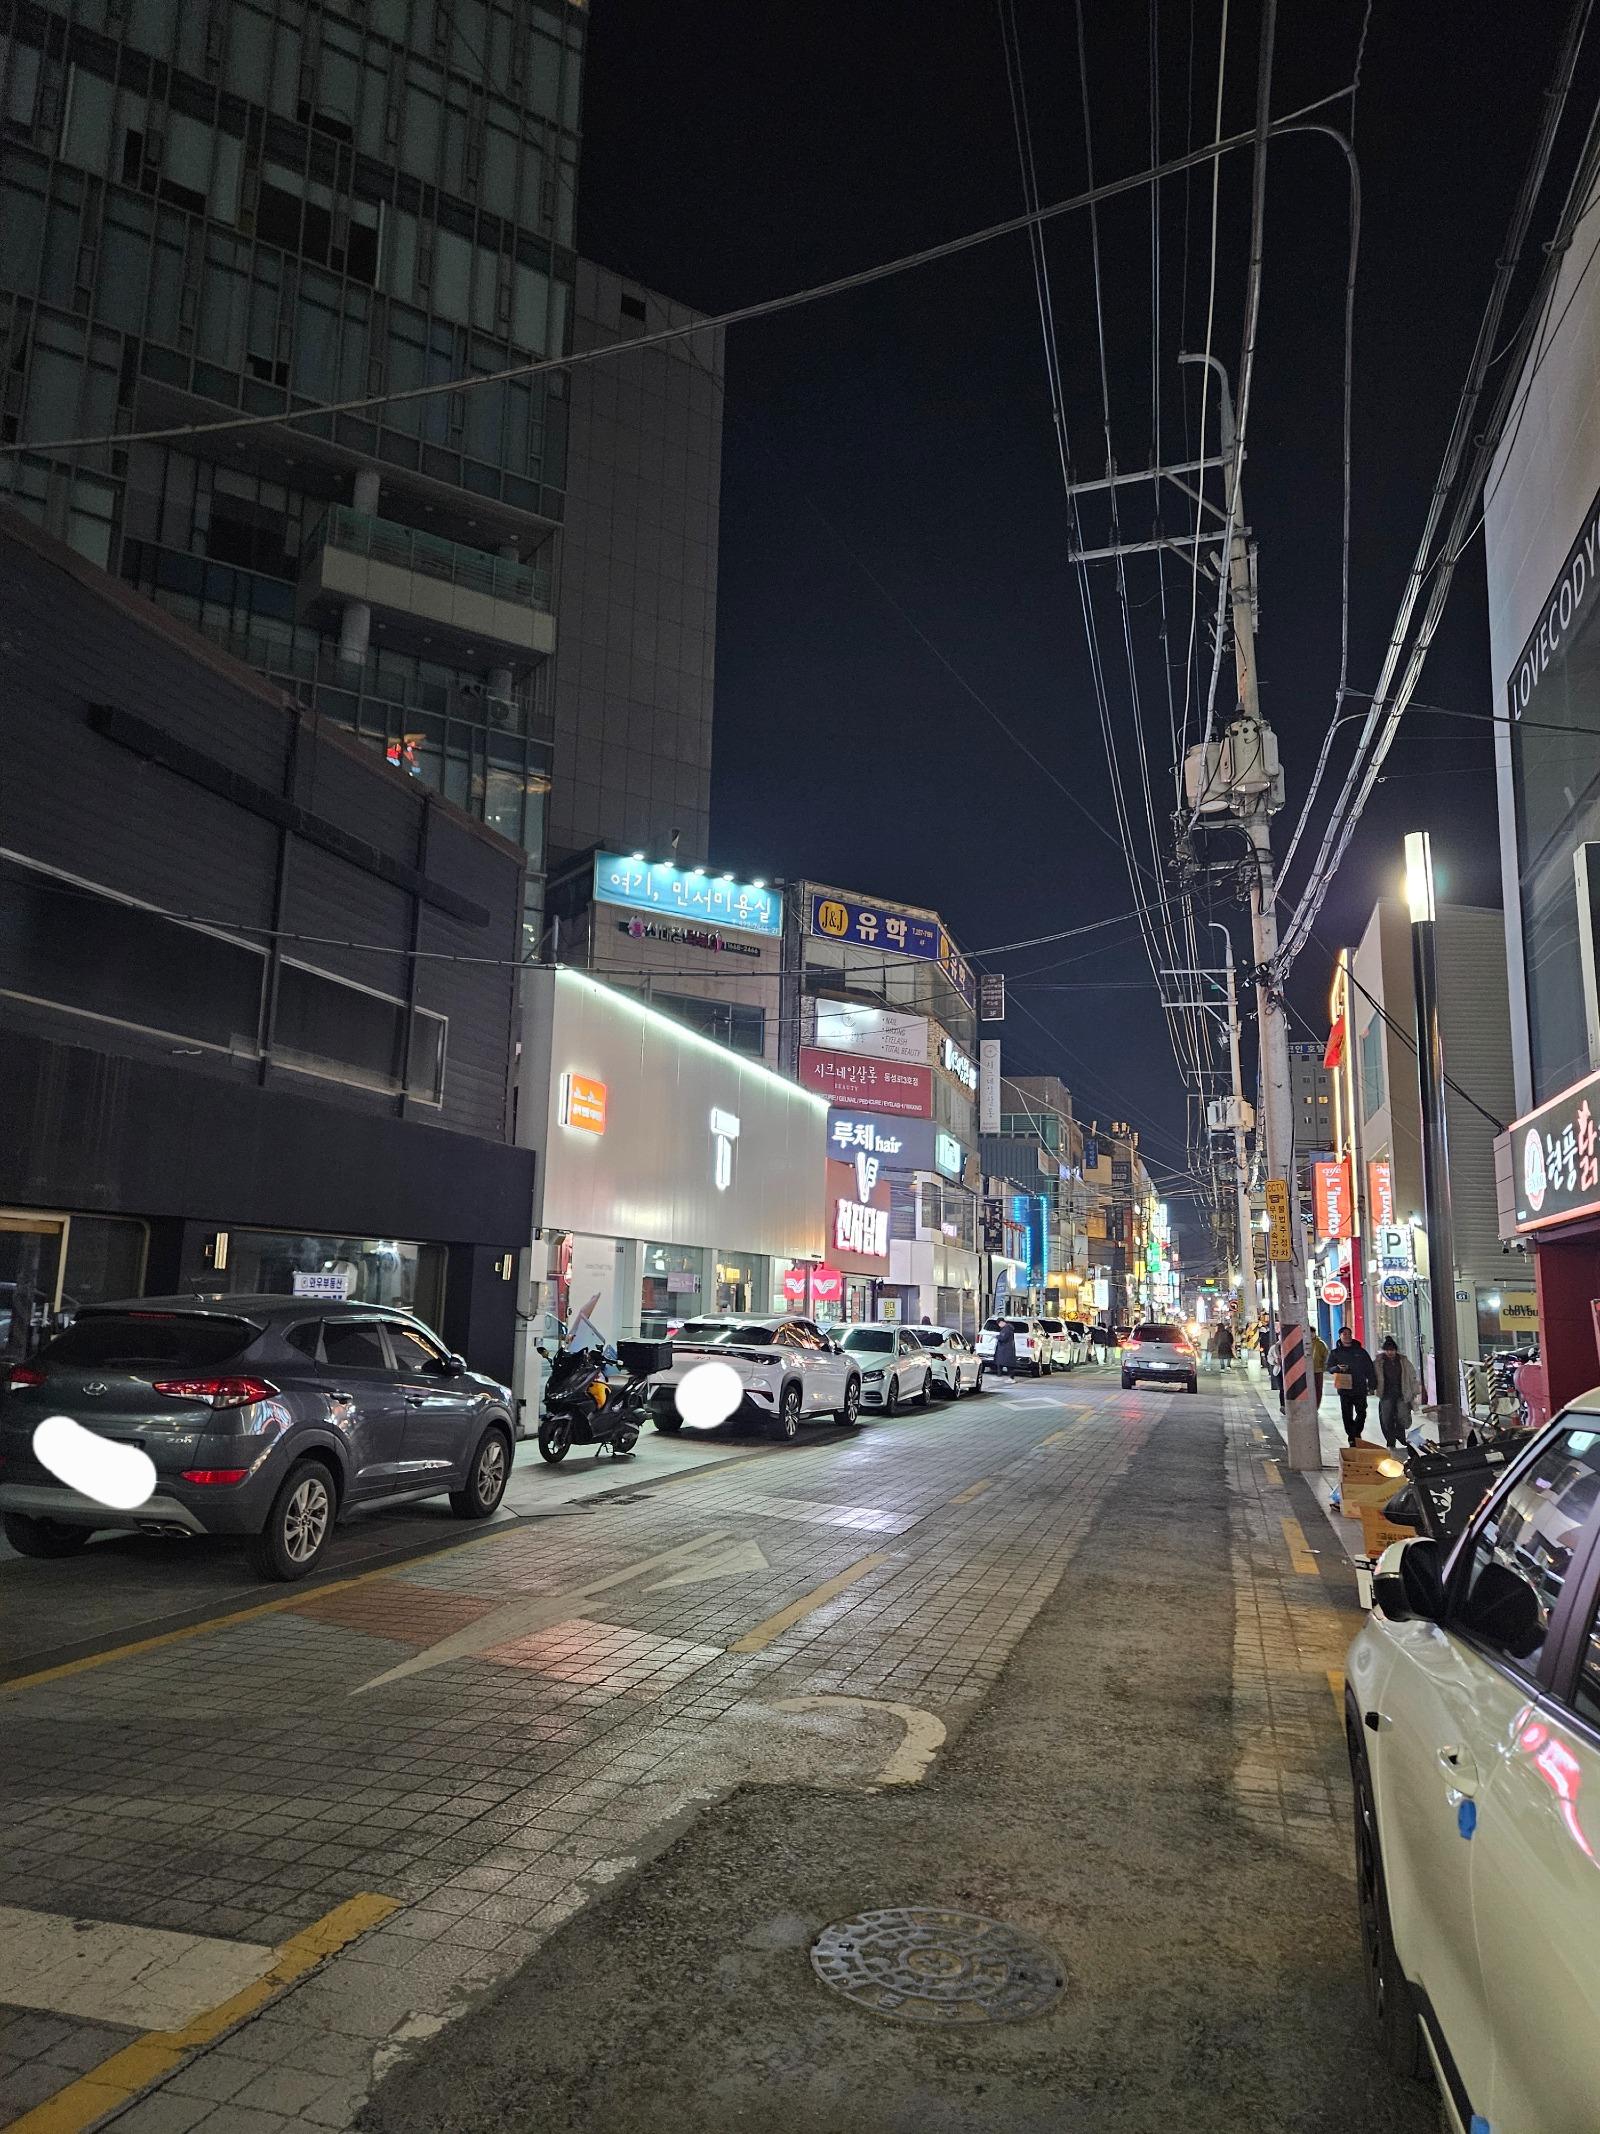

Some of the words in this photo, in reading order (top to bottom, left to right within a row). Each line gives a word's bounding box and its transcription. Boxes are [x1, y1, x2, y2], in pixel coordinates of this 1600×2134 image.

[610, 871, 659, 901] 여기,
[672, 880, 772, 923] 민서미용실
[821, 905, 844, 932] J&J
[856, 912, 908, 948] 유학
[814, 1063, 878, 1084] 시크네일살롱
[832, 1121, 874, 1150] 루체
[875, 1136, 902, 1153] hair
[1387, 1233, 1401, 1254] P
[1384, 1258, 1408, 1269] 주차장
[309, 1277, 342, 1289] 와우부동산
[1385, 1284, 1408, 1297] 주차장
